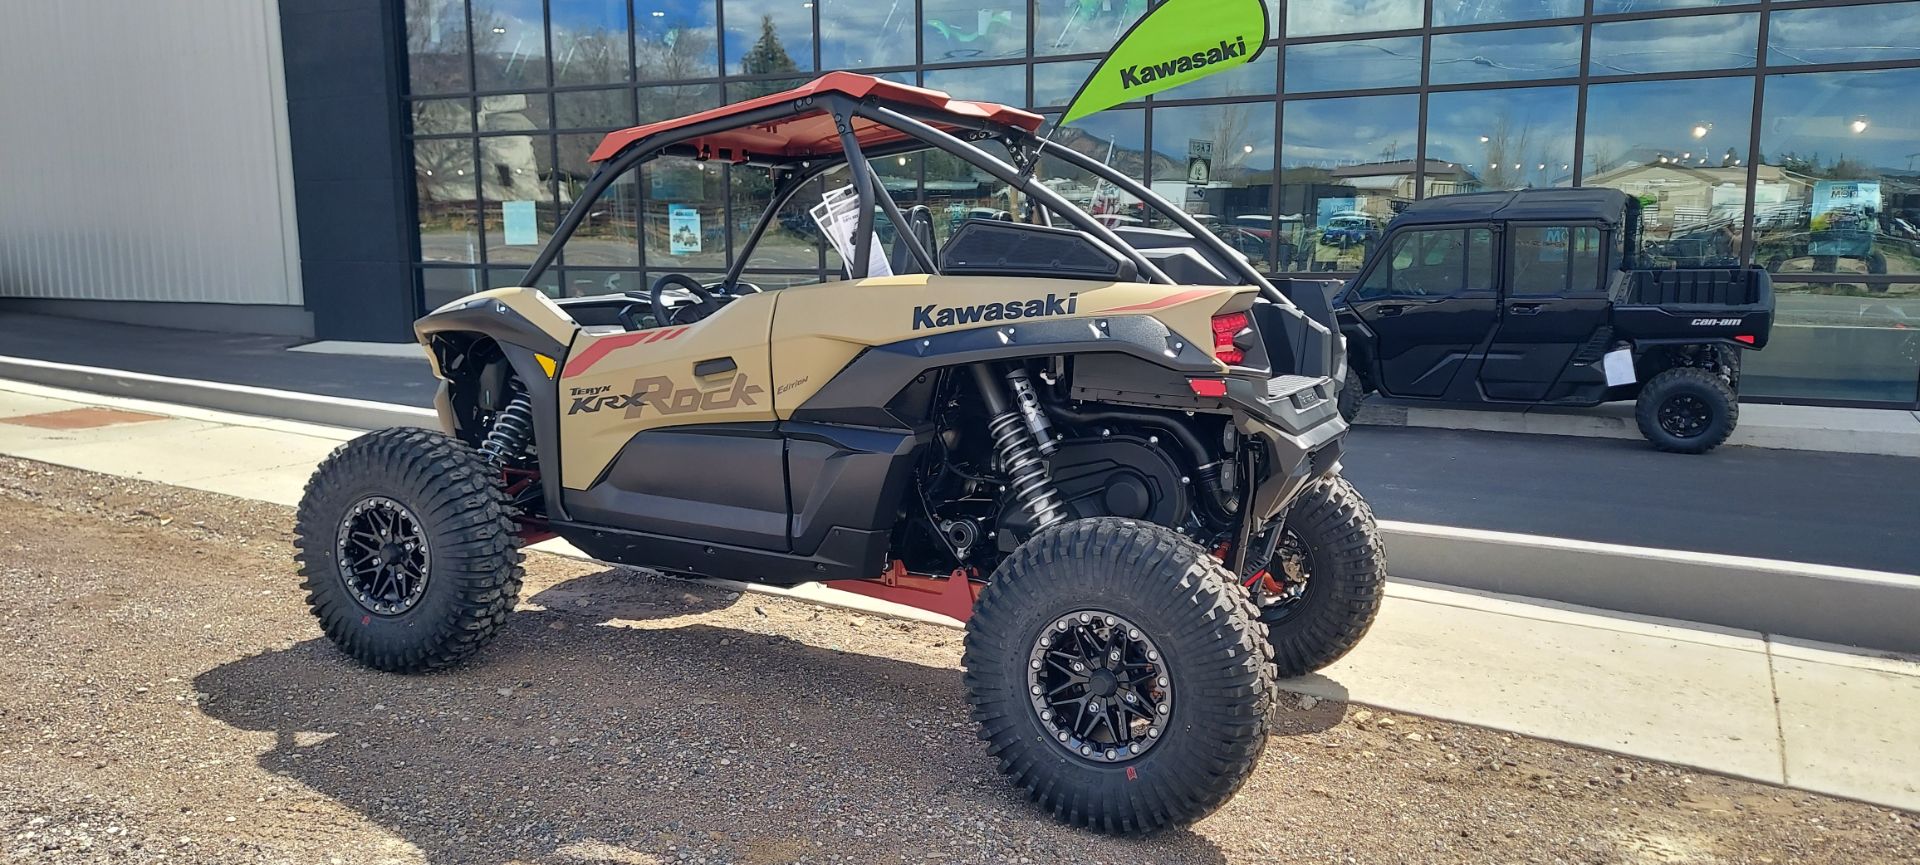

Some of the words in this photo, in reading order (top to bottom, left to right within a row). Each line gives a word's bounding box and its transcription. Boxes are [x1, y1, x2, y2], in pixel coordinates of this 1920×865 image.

[1120, 36, 1247, 89] Kawasaki
[912, 292, 1079, 331] Kawasaki
[1691, 318, 1742, 326] can-am
[567, 391, 650, 416] KRX
[624, 373, 765, 420] Rock
[777, 376, 809, 396] Edition
[1013, 378, 1046, 421] FOX
